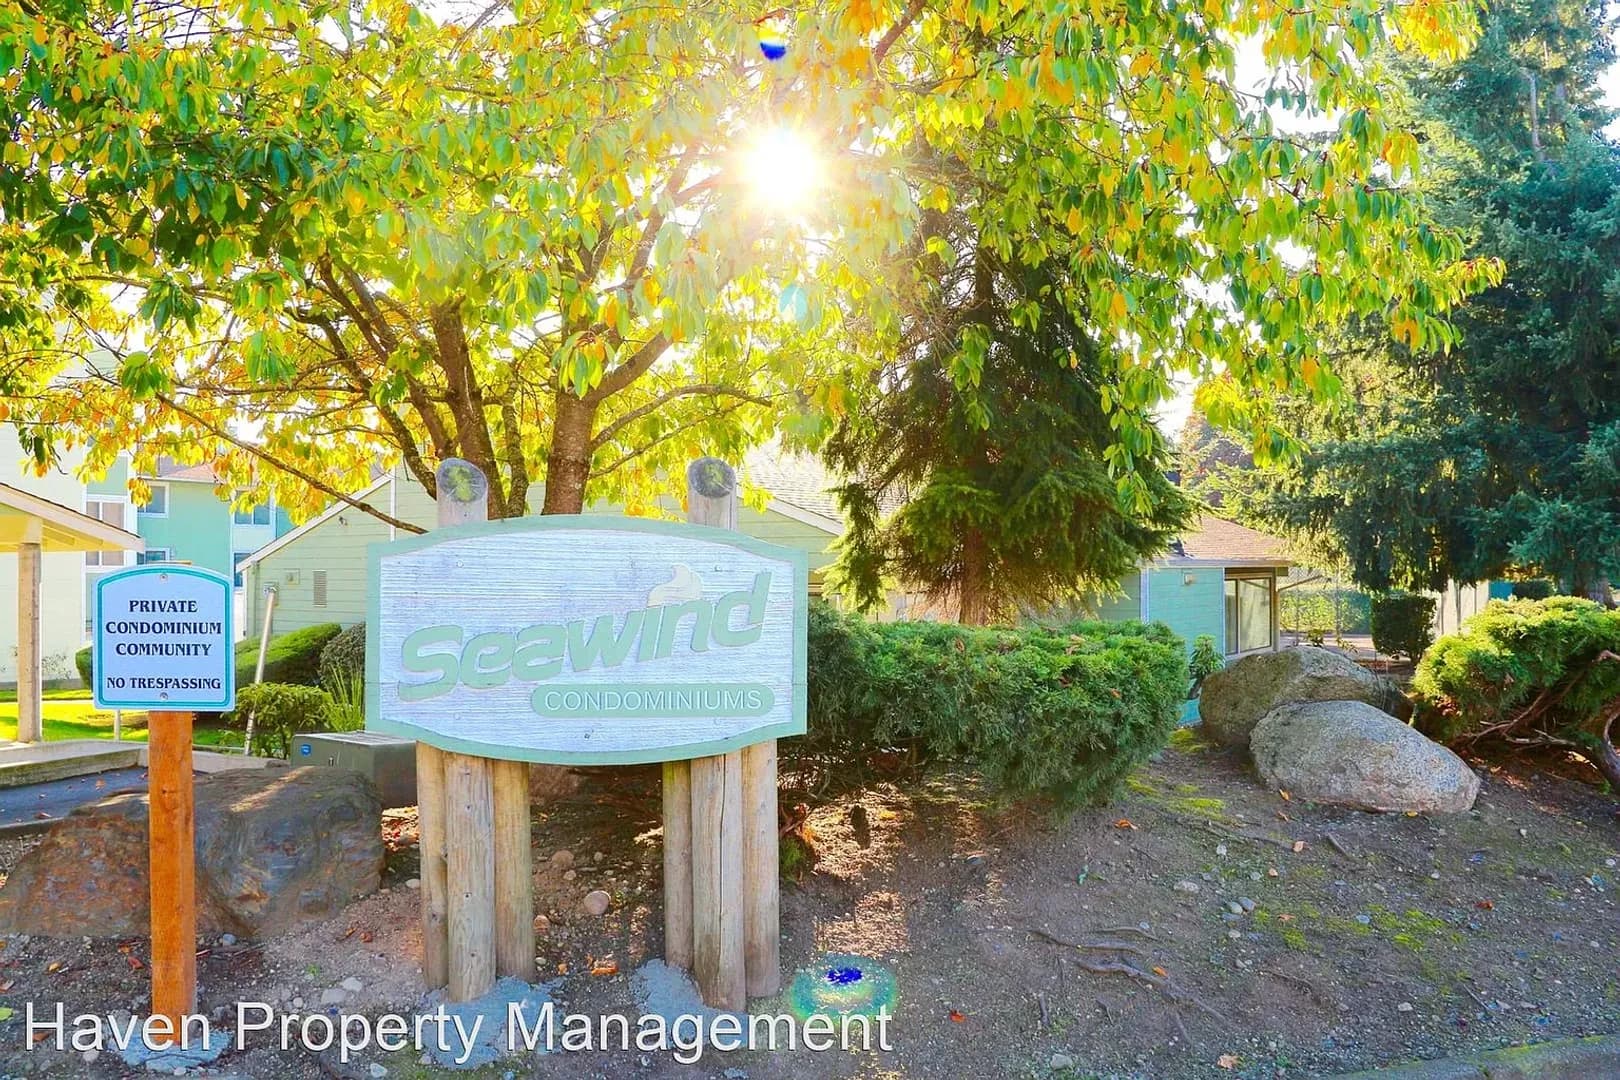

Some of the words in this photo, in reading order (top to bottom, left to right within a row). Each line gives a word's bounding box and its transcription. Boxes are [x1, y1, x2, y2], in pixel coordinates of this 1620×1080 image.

[129, 600, 198, 613] PRIVATE
[105, 621, 222, 635] CONDOMINIUM
[398, 571, 772, 701] Seawind
[115, 643, 212, 656] COMMUNITY
[106, 677, 126, 689] NO
[129, 677, 221, 689] TRESPASSING
[544, 689, 763, 711] CONDOMINIUMS
